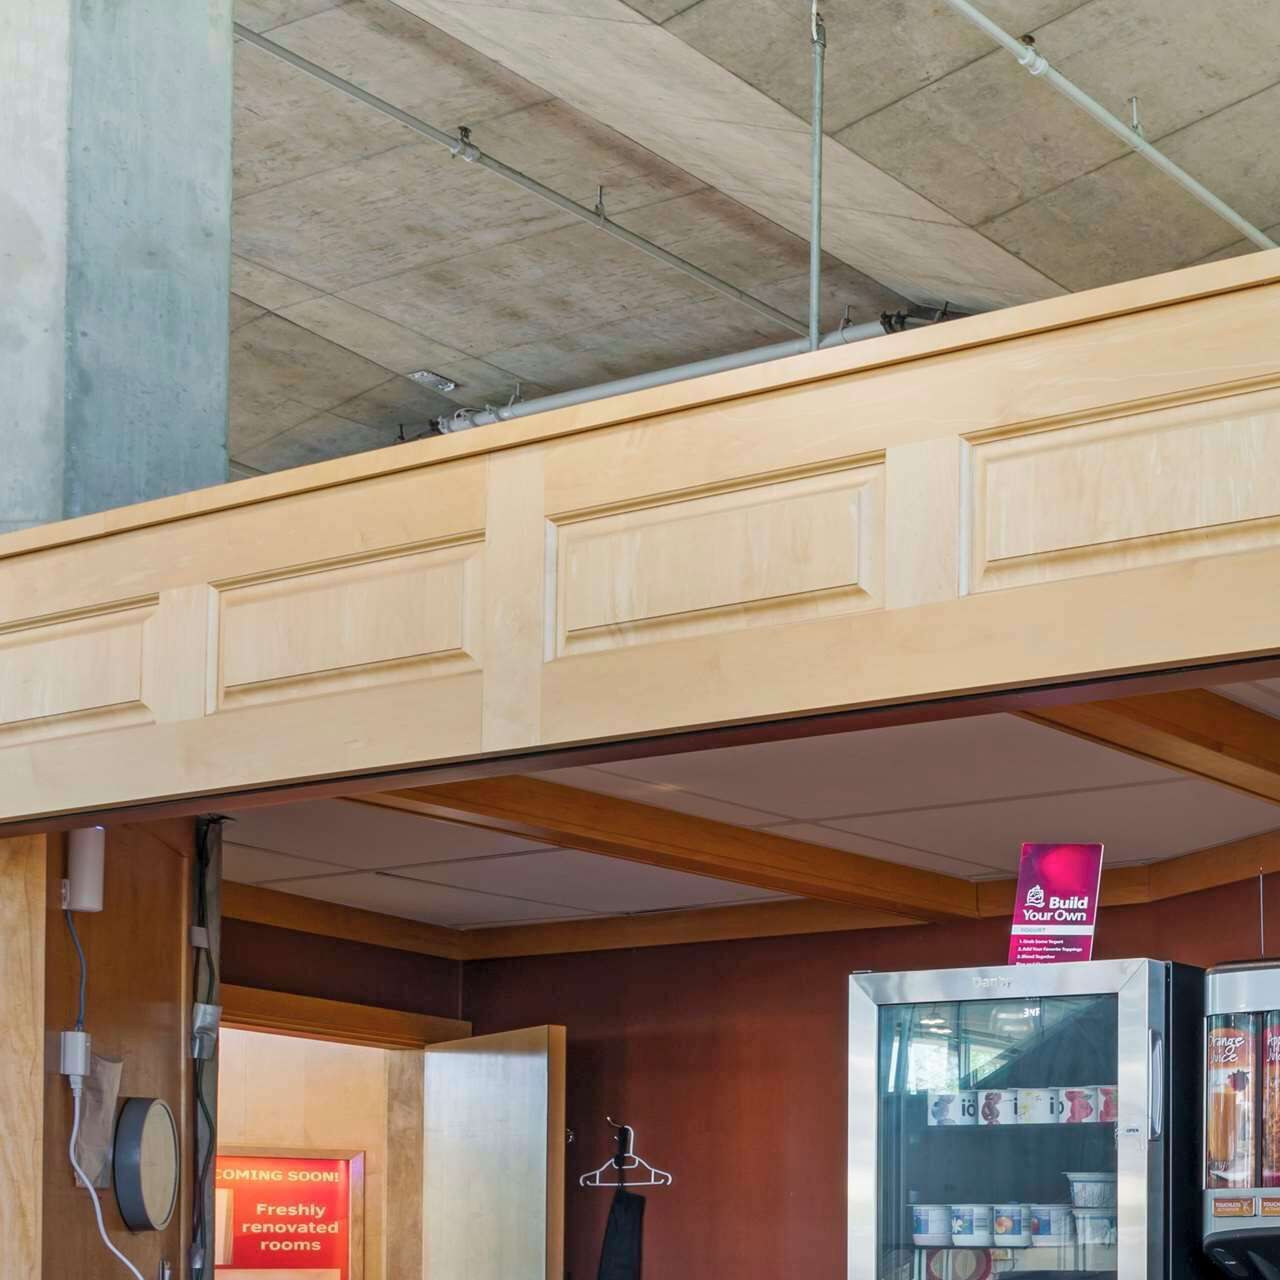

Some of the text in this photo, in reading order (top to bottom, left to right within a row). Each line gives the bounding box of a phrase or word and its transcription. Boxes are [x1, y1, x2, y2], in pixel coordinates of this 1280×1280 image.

[1049, 896, 1088, 909] Build
[1023, 909, 1087, 921] Your Own
[1209, 1034, 1245, 1055] Orange
[287, 1170, 340, 1182] SOON!
[256, 1203, 326, 1218] Freshly
[242, 1221, 339, 1234] renovated
[260, 1240, 321, 1251] rooms
